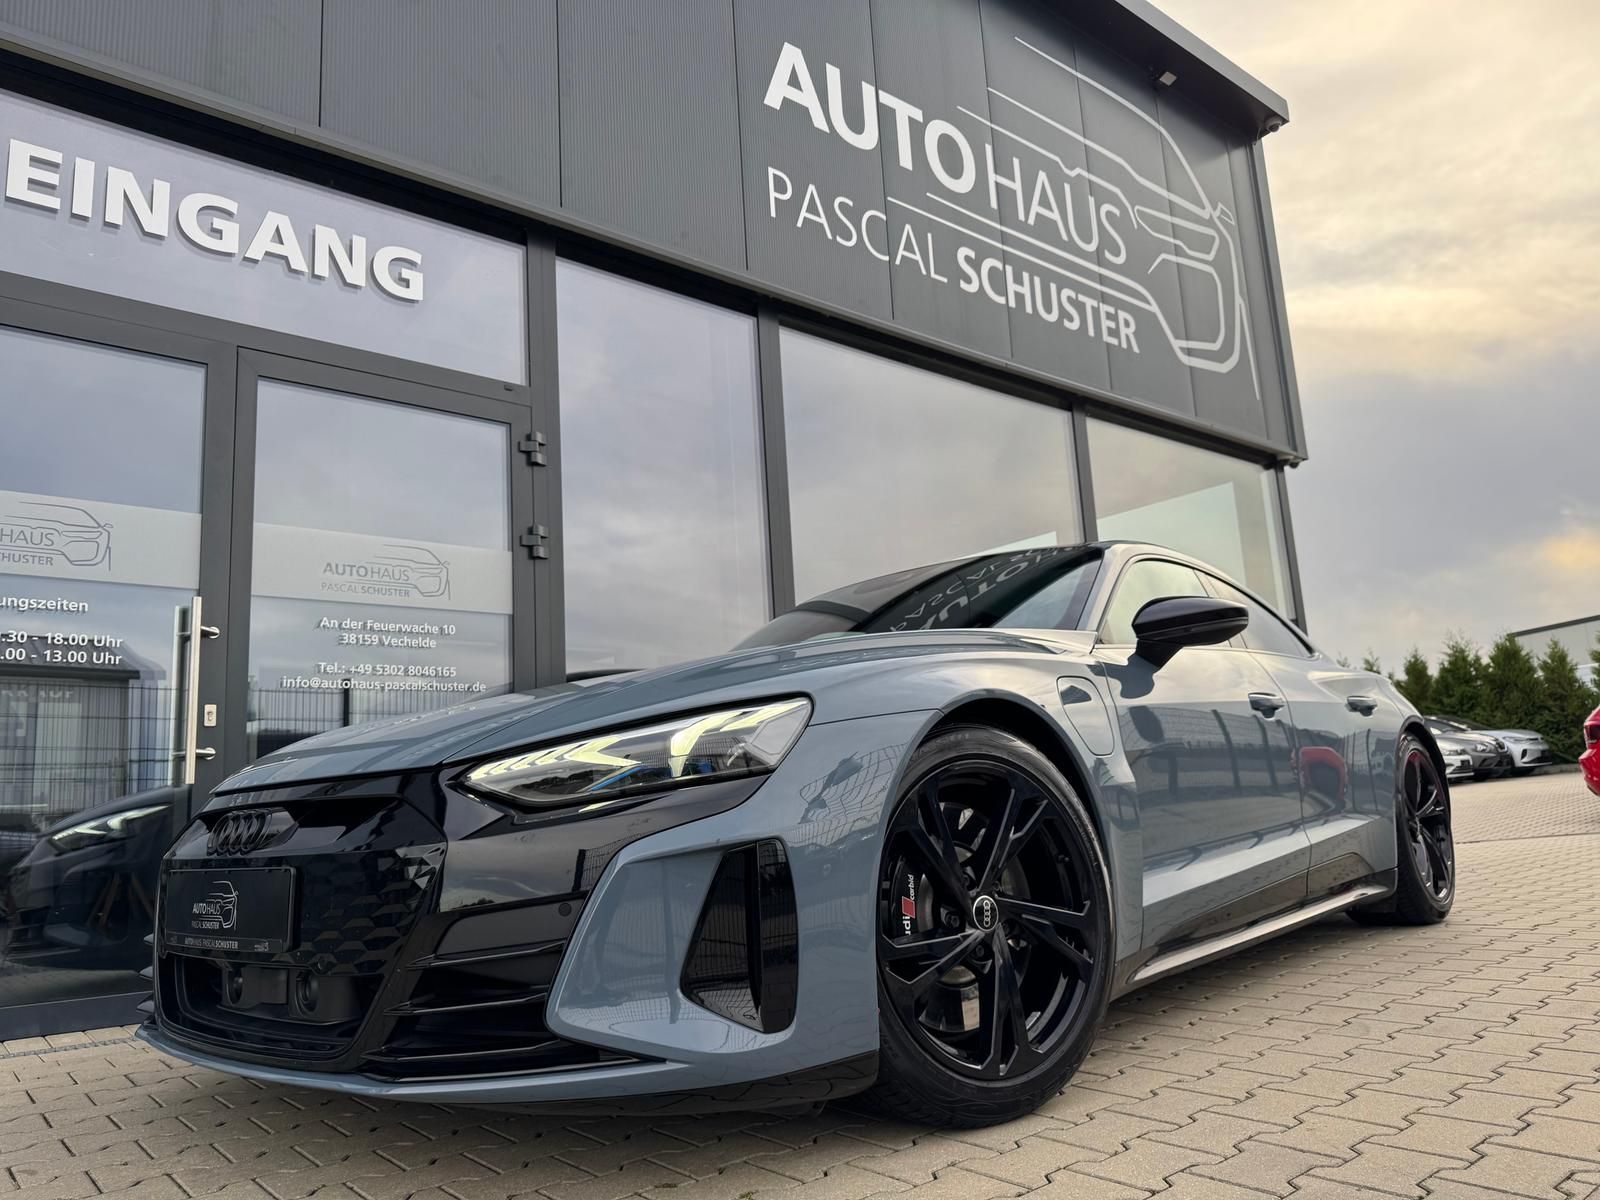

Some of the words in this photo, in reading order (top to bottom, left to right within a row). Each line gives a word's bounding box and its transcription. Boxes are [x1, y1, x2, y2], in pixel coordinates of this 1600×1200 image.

[6, 138, 424, 302] EINGANG
[767, 166, 948, 284] PASCAL
[956, 246, 1141, 354] SCHUSTER
[320, 617, 338, 628] An
[342, 618, 363, 630] der
[367, 620, 439, 634] Feuerwache
[443, 624, 456, 634] 10
[0, 630, 28, 644] .30
[45, 632, 88, 646] 18.00
[94, 635, 123, 648] Uhr
[342, 633, 379, 645] 38159
[382, 635, 437, 648] Vechelde
[43, 649, 87, 663] 13.00
[92, 652, 122, 665] Uhr
[319, 662, 345, 674] Tel.:
[350, 664, 372, 675] +49
[376, 664, 404, 676] 5302
[408, 666, 457, 677] 8046165
[283, 676, 487, 693] info@autohaus-pascalschuster.de
